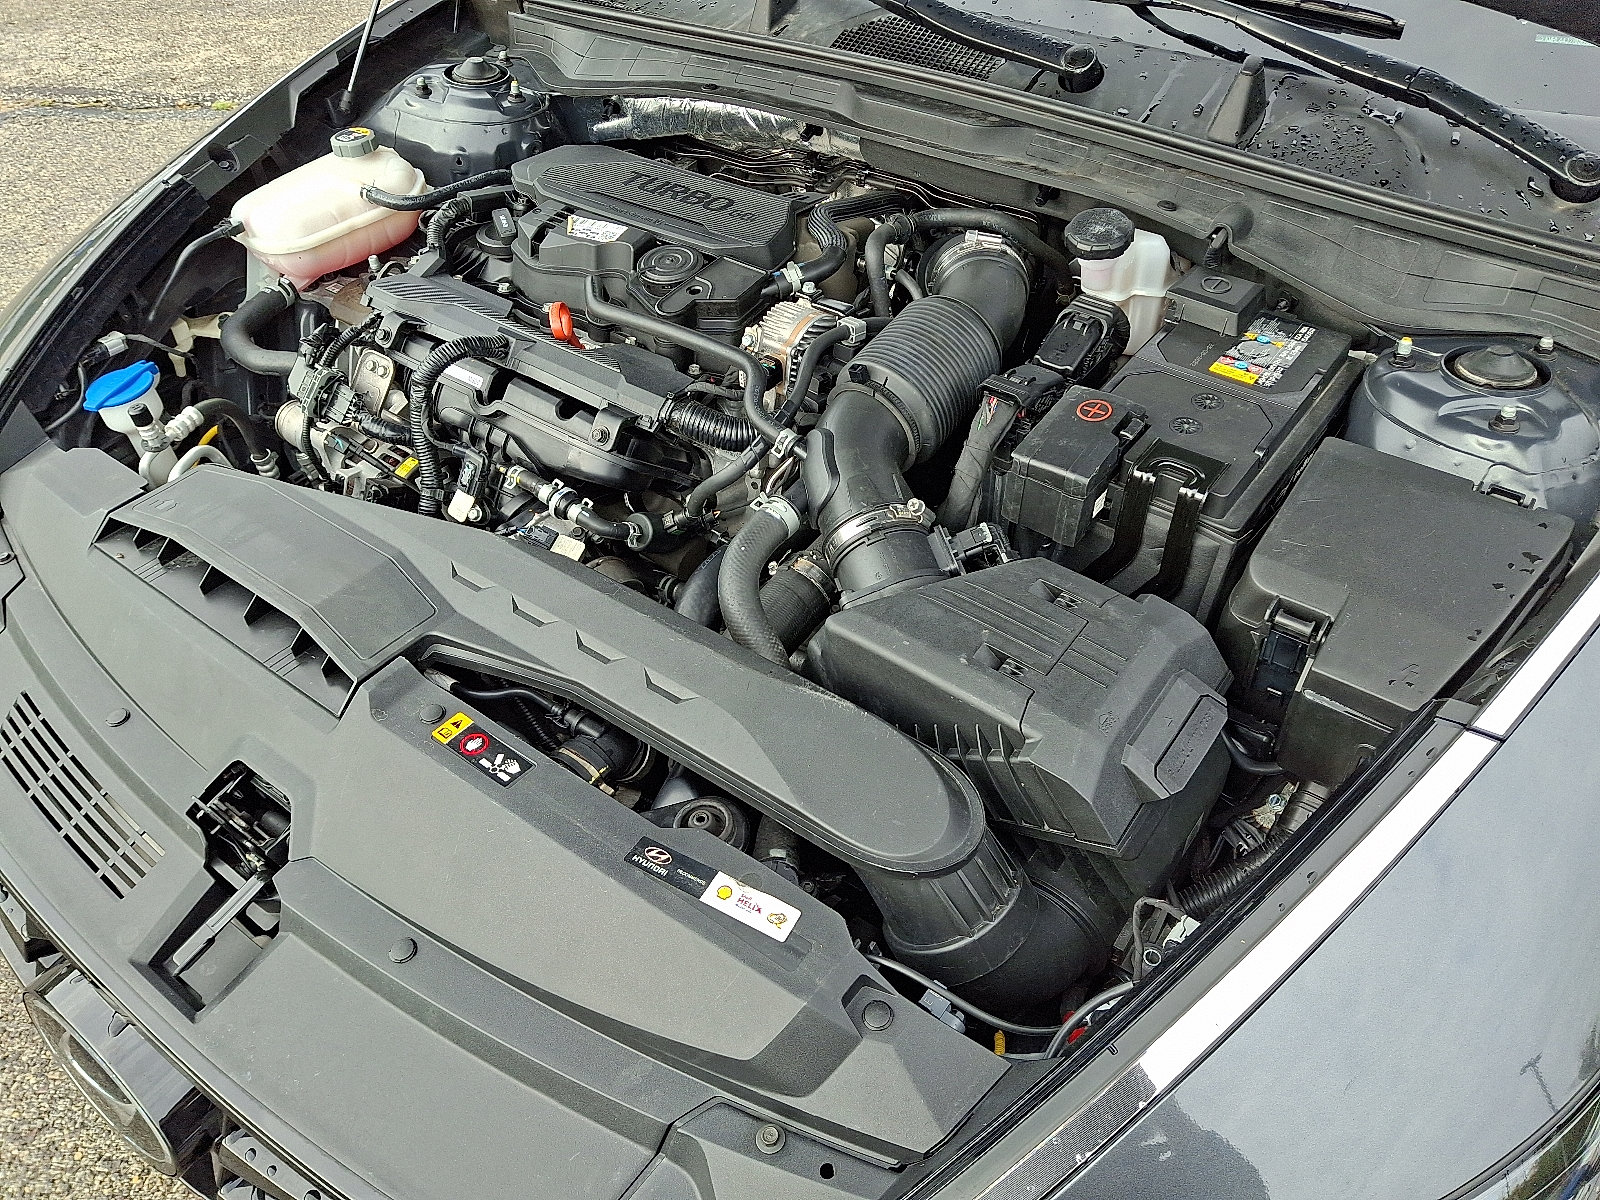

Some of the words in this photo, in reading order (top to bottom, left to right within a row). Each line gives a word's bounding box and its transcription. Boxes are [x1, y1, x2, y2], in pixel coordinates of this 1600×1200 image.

[622, 171, 735, 212] TURBO
[632, 854, 669, 877] HYUNDAI
[736, 897, 762, 914] HELIX
